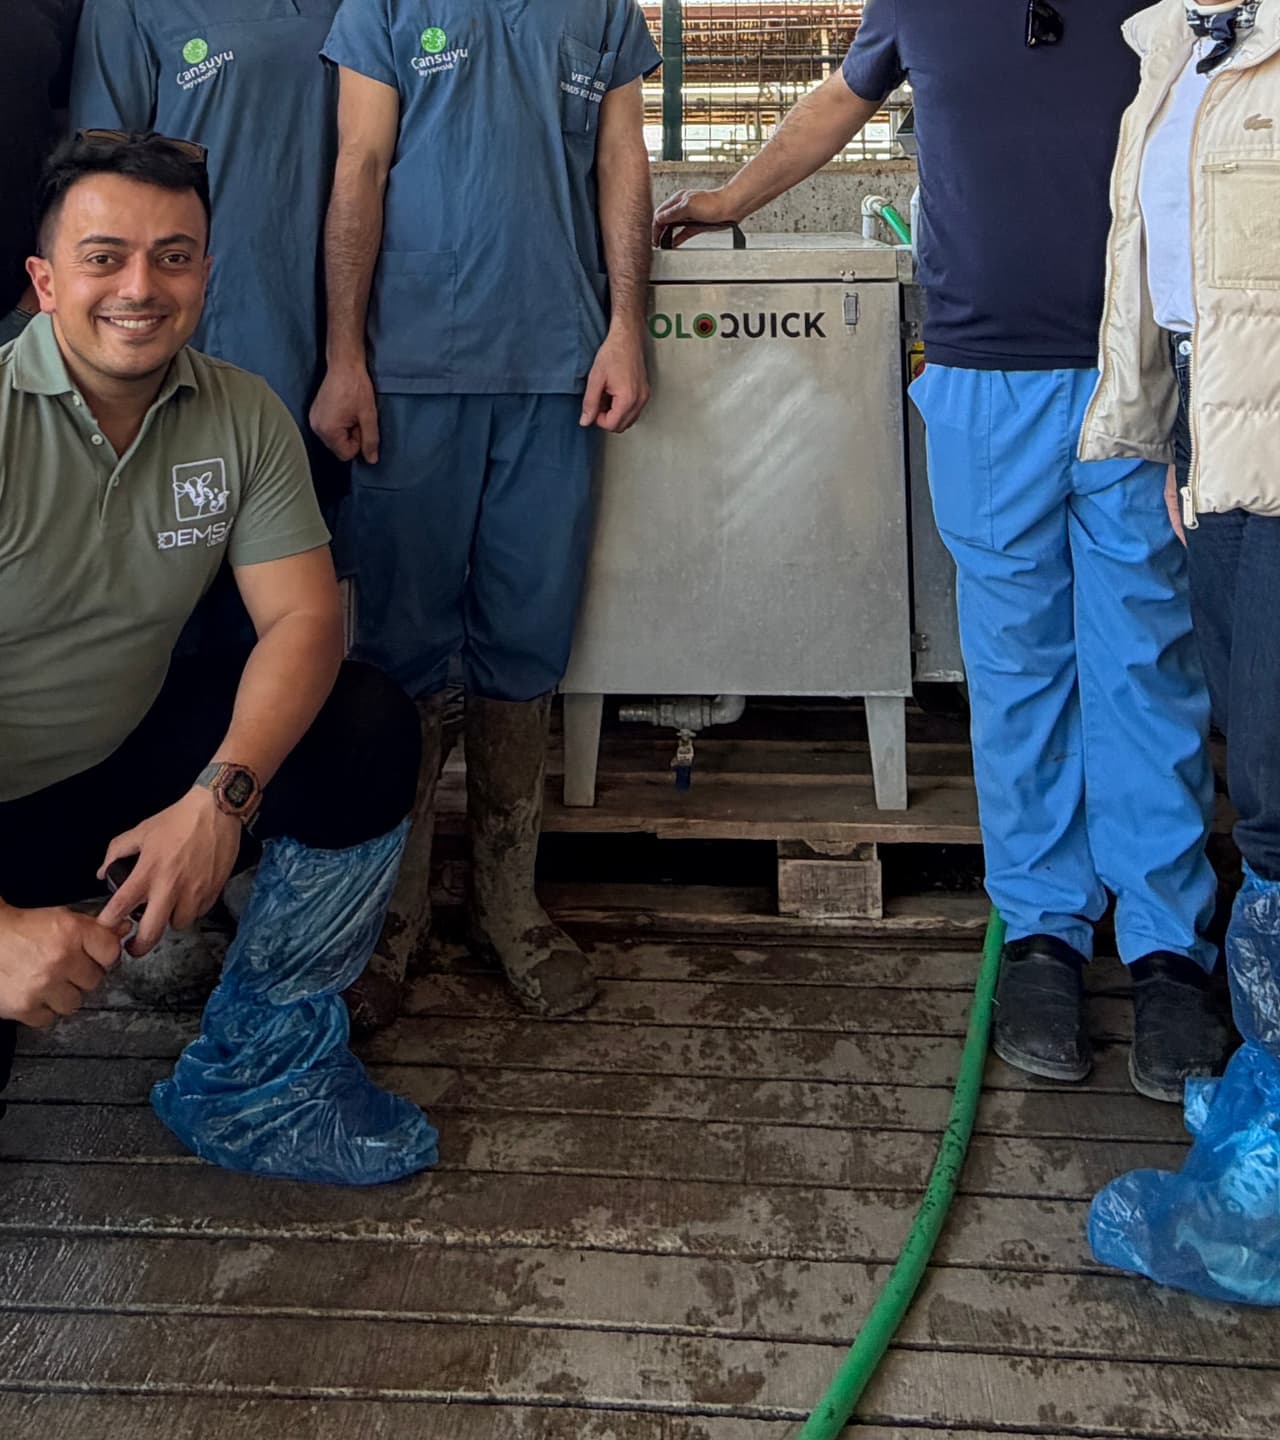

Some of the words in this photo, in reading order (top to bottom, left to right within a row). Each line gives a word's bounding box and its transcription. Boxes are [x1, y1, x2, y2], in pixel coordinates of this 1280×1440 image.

[175, 50, 235, 85] Cansuyu
[410, 48, 469, 70] Cansuyu
[647, 311, 828, 340] OLOQUICK
